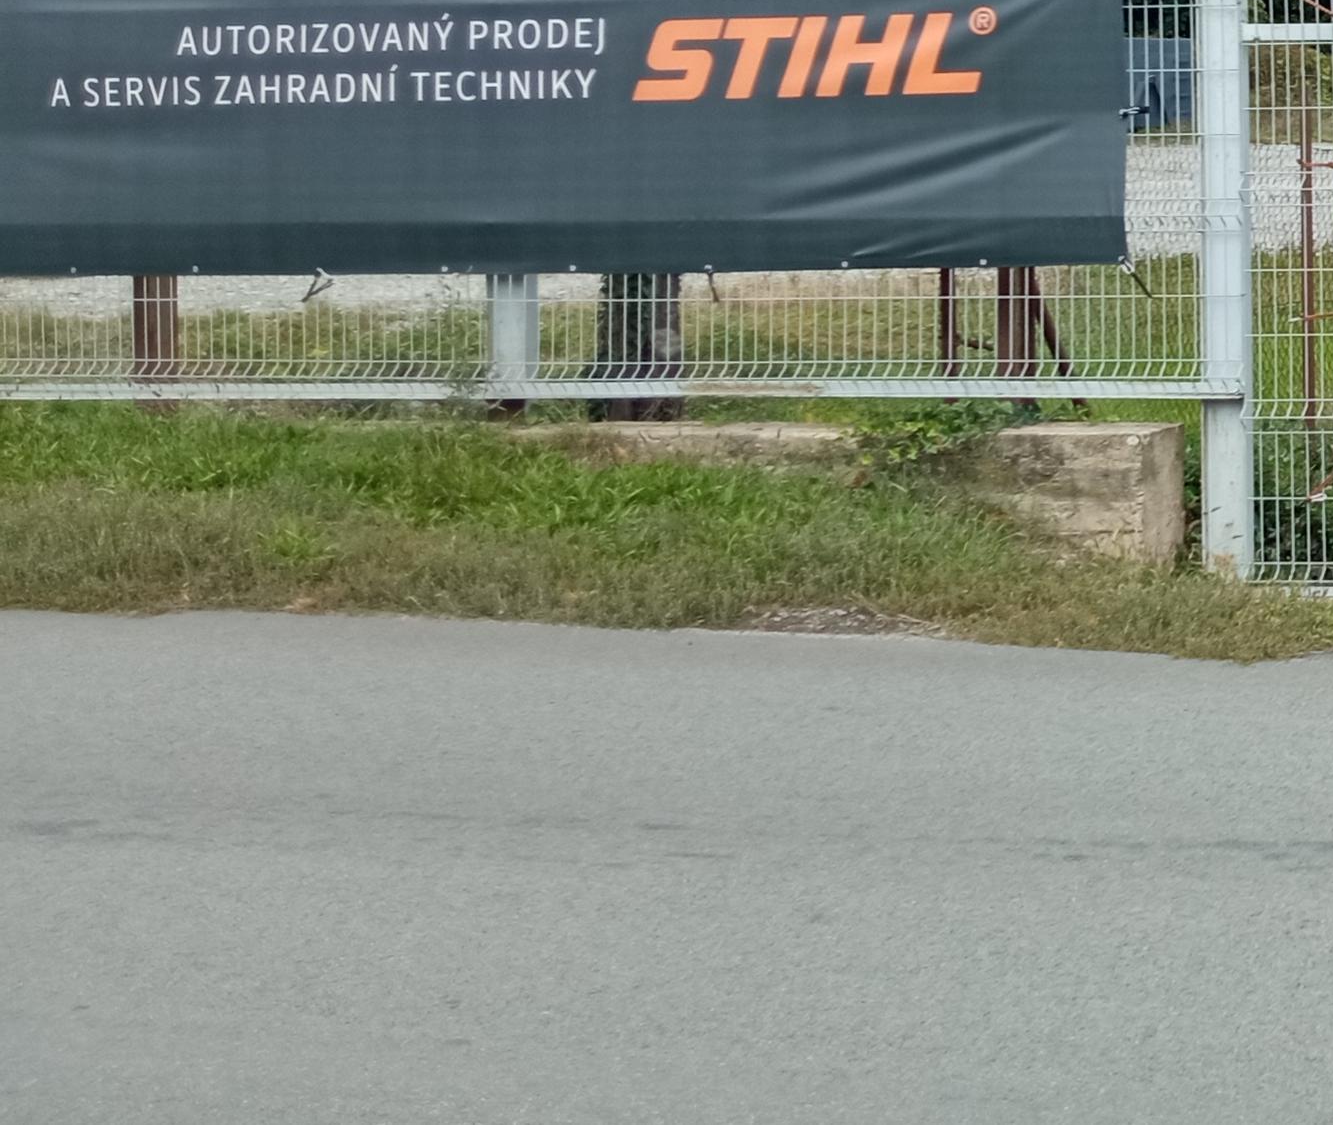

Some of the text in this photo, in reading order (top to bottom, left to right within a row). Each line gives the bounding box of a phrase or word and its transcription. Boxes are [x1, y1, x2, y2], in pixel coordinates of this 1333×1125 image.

[177, 13, 605, 56] AUTORIZOVANÝ PRODEJ
[51, 64, 597, 107] A SERVIS ZAHRADNÍ TECHNIKY
